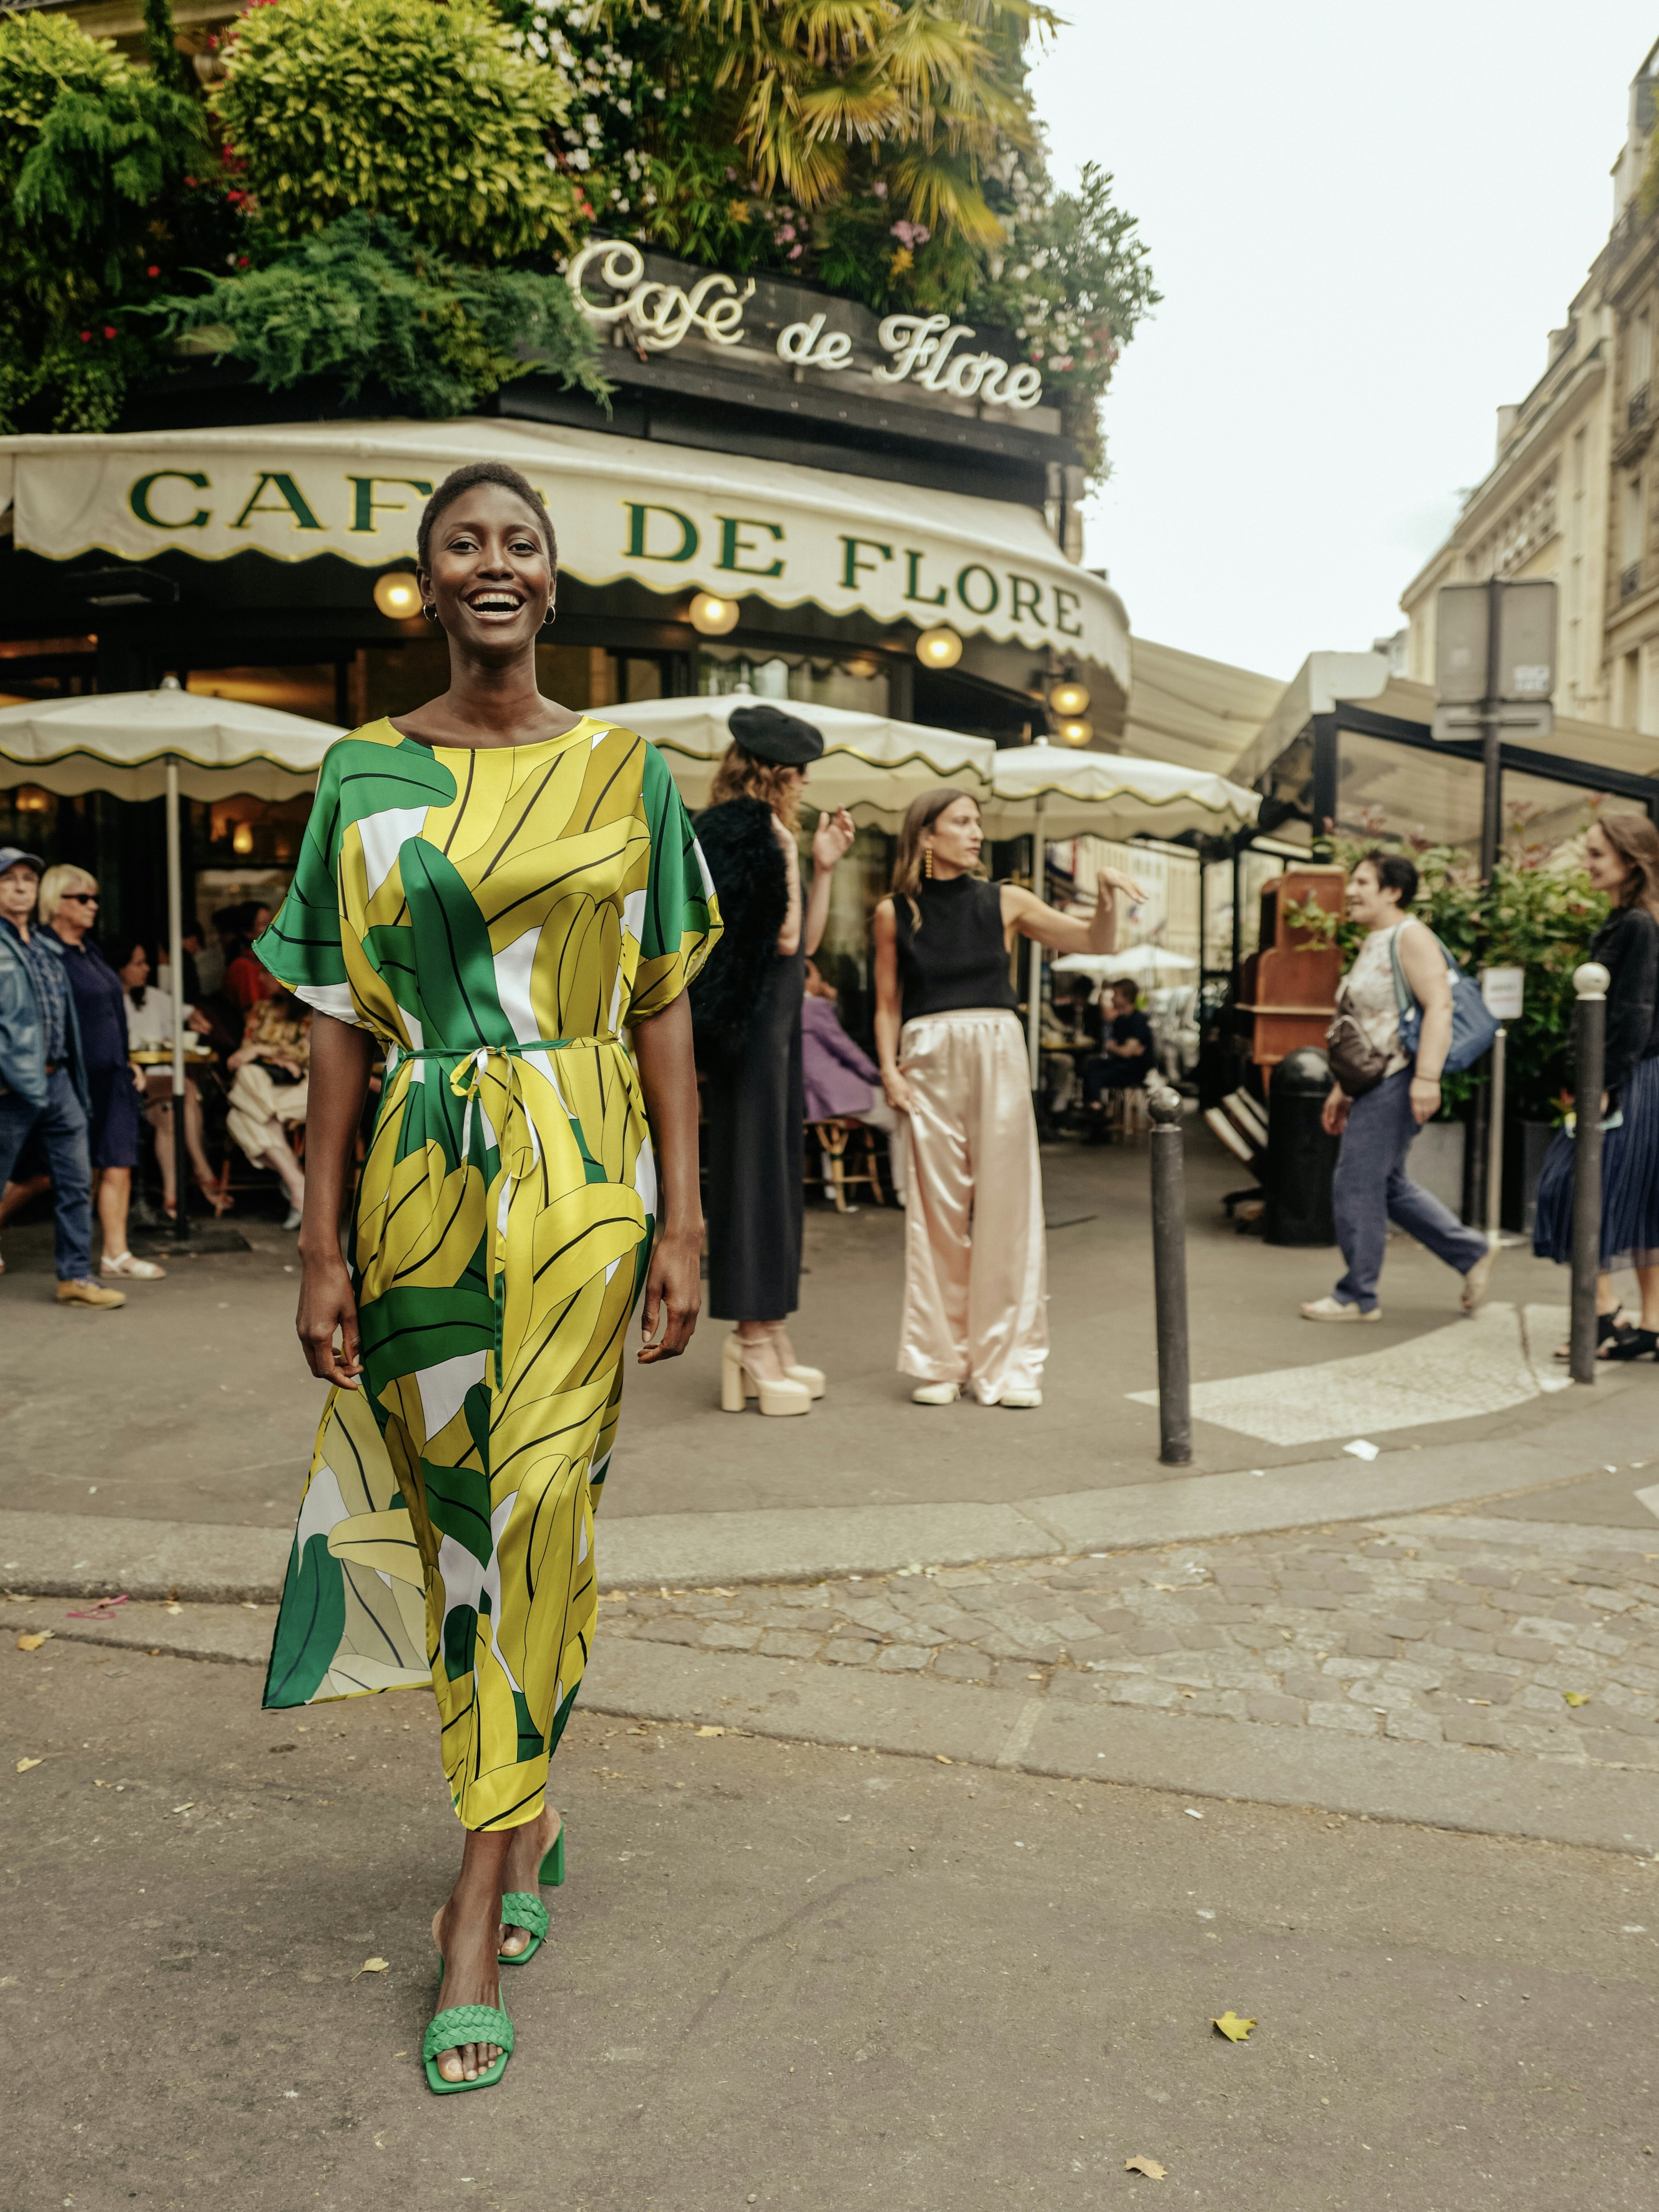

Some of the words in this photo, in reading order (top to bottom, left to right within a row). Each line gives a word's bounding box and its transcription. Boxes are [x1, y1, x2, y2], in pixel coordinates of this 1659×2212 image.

[777, 312, 853, 370] de
[872, 313, 1044, 410] Flore
[128, 470, 549, 533] CAF
[622, 500, 786, 579] DE
[837, 533, 1083, 638] FLORE
